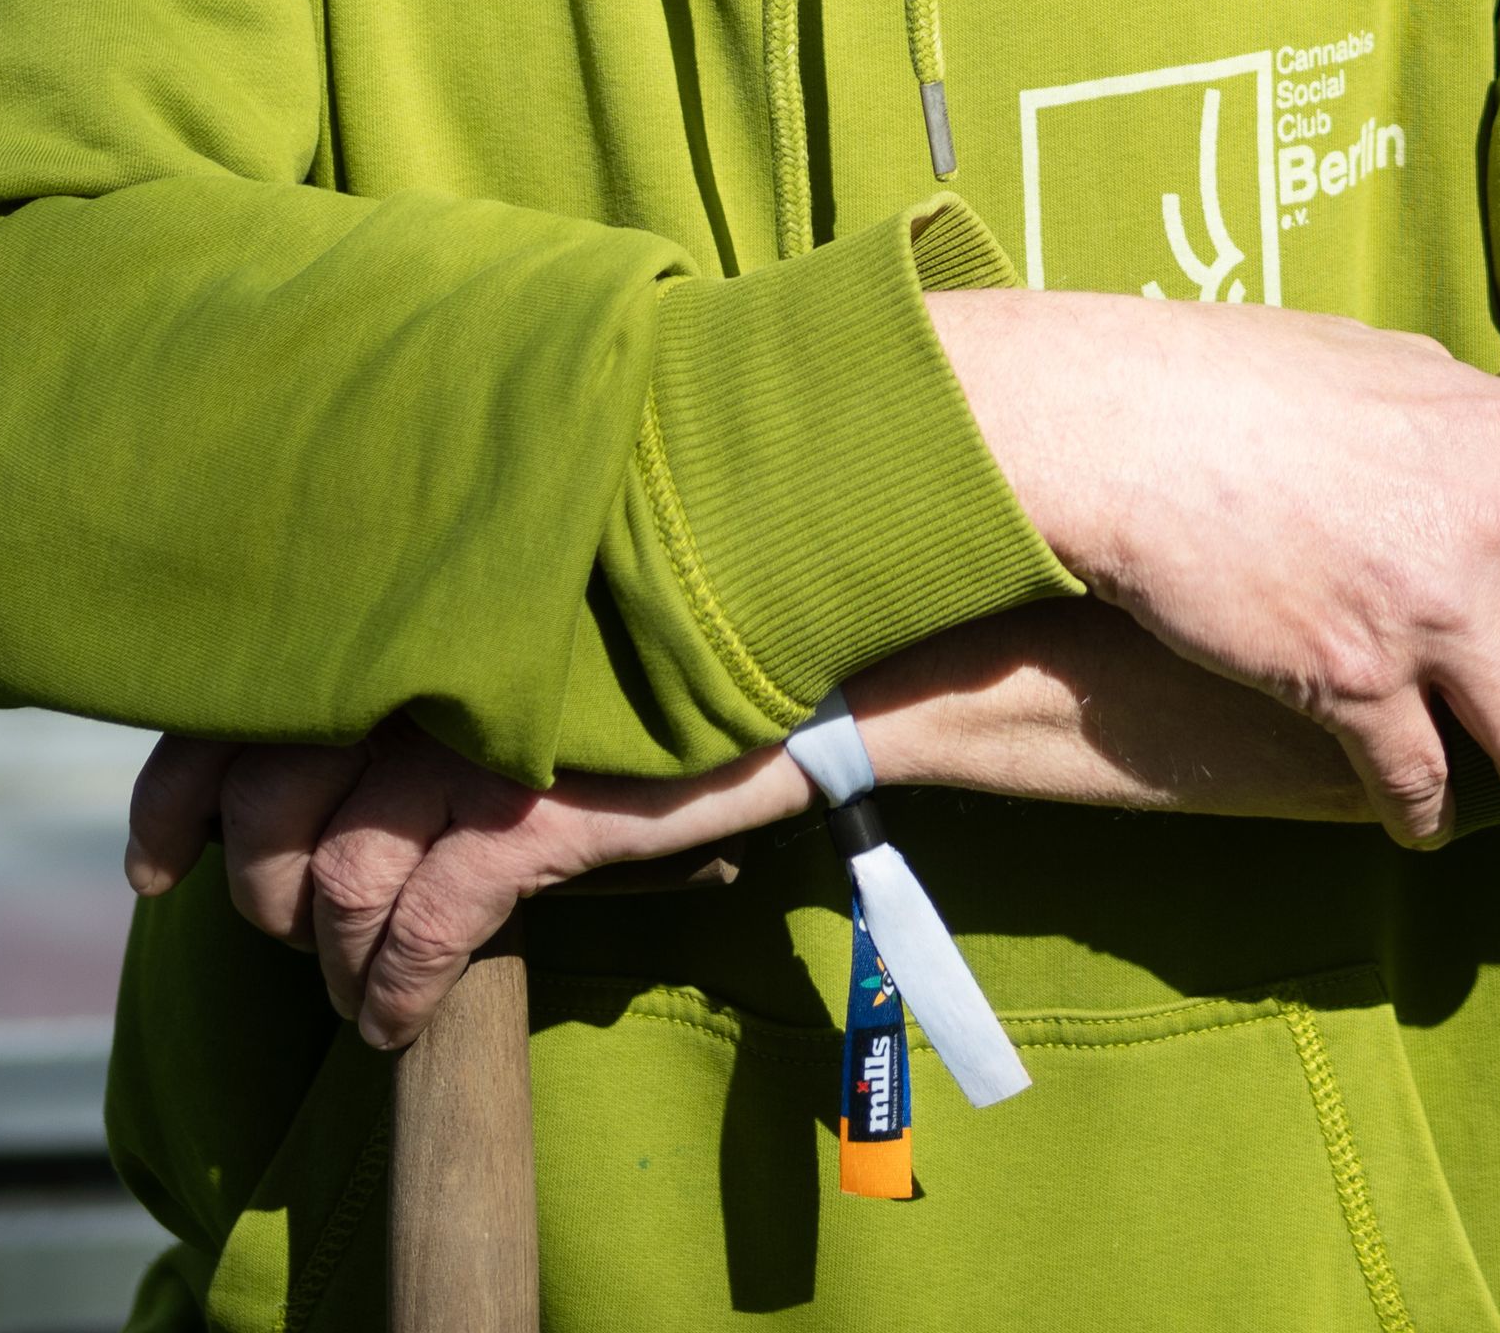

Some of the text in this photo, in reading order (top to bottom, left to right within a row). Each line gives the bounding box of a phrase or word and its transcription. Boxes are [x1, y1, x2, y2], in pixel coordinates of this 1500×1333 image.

[1276, 30, 1375, 74] Cannabis
[1276, 69, 1345, 109] Social
[1277, 109, 1331, 143] Club
[1278, 117, 1405, 205] Berlin
[857, 1036, 890, 1132] mills
